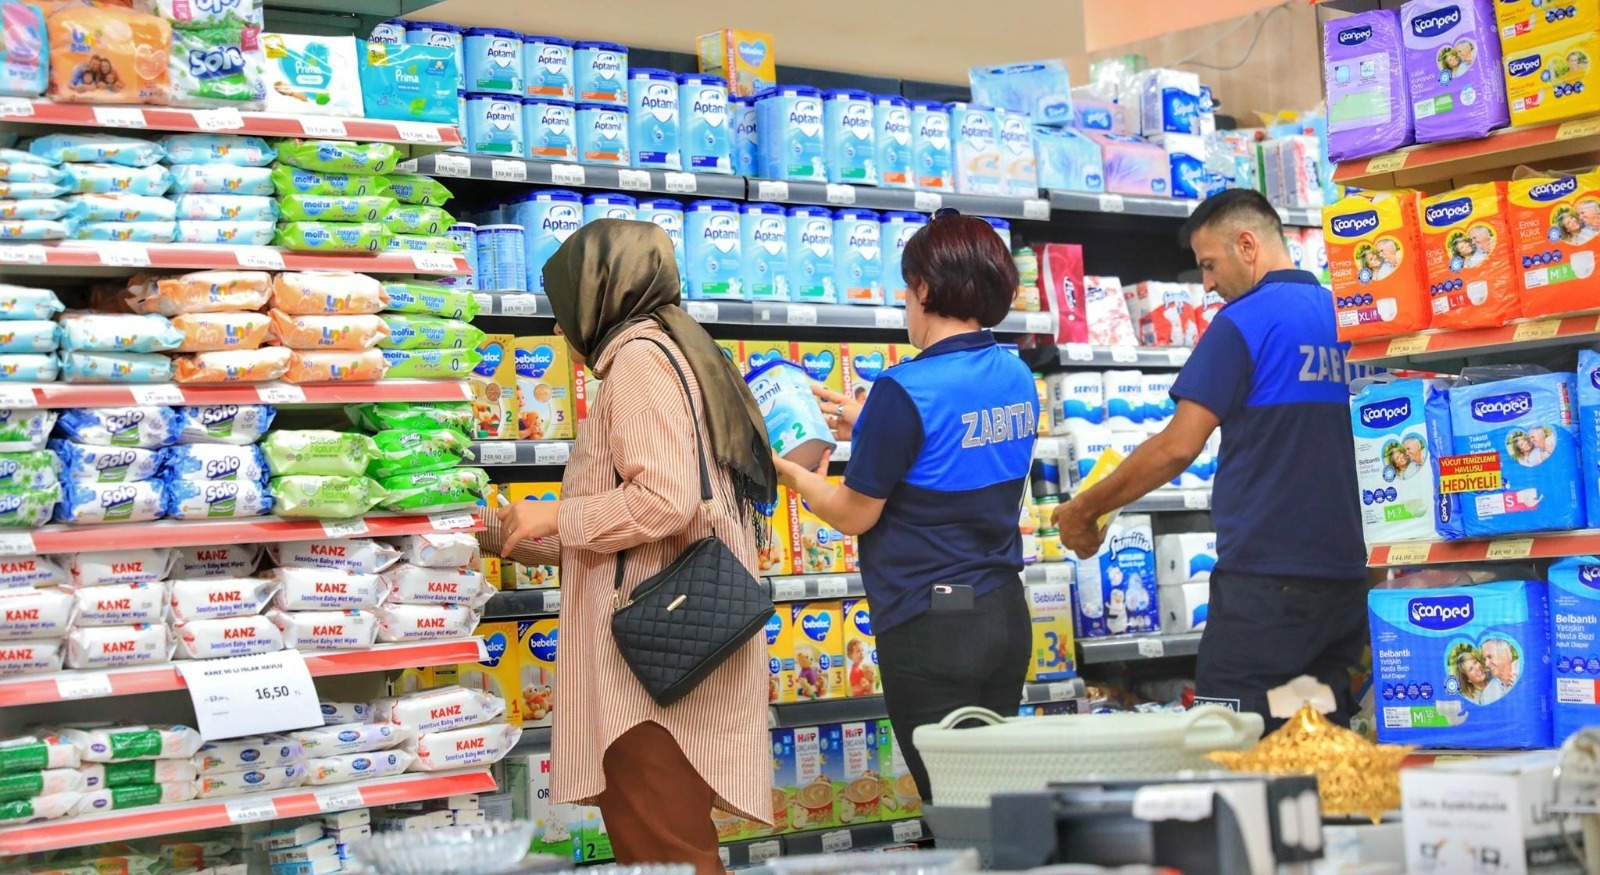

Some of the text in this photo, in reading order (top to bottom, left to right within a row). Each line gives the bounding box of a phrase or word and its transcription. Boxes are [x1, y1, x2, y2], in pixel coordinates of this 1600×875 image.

[1419, 10, 1459, 32] canped
[1342, 29, 1372, 42] canped
[488, 48, 516, 58] Aptamil
[538, 54, 566, 66] Aptamil
[1511, 57, 1540, 75] canped
[592, 61, 620, 72] Aptamil
[396, 69, 418, 82] Prima
[487, 112, 515, 122] Aptamil
[542, 116, 569, 126] Aptamil
[595, 121, 622, 132] Aptamil
[1535, 181, 1575, 198] canped
[1431, 203, 1470, 221] canped
[1340, 217, 1377, 234] canped
[305, 230, 330, 238] molfix
[1550, 270, 1559, 280] M
[1450, 299, 1456, 307] L
[1359, 313, 1370, 321] XL
[203, 404, 238, 423] Solo
[1369, 404, 1409, 422] canped
[1480, 398, 1529, 417] canped
[106, 411, 144, 433] Solo
[505, 411, 513, 422] 2
[557, 411, 564, 422] 3
[792, 422, 807, 440] 2
[962, 402, 1036, 449] ZABITA
[97, 450, 136, 469] Solo
[1441, 455, 1496, 466] VÜCUT TEMİZLEME
[207, 456, 240, 477] Solo
[1455, 465, 1482, 473] HAVLUSU
[1443, 472, 1497, 492] HEDİYELİ!
[102, 485, 137, 506] Solo
[206, 482, 238, 502] Solo
[1505, 495, 1514, 507] S
[792, 497, 803, 553] EKONOMİK
[197, 550, 228, 561] KANZ
[311, 545, 345, 557] KANZ
[836, 545, 842, 558] 2
[1, 561, 36, 574] KANZ
[112, 562, 142, 574] KANZ
[347, 559, 362, 568] Wipes
[490, 561, 498, 574] 1
[316, 582, 347, 593] KANZ
[428, 582, 458, 593] KANZ
[209, 591, 242, 603] KANZ
[301, 594, 324, 602] Sensitive
[325, 595, 337, 603] Baby
[436, 594, 448, 602] Baby
[97, 599, 131, 610] KANZ
[6, 609, 39, 621] KANZ
[1419, 603, 1470, 621] canped
[417, 618, 445, 628] KANZ
[803, 620, 830, 628] bebelac
[1556, 614, 1597, 624] Belbantlı
[224, 627, 255, 639] KANZ
[313, 625, 343, 636] KANZ
[1556, 632, 1594, 640] Hasta Bezi
[103, 641, 136, 653] KANZ
[322, 637, 334, 645] Baby
[0, 648, 33, 660] KANZ
[1044, 631, 1060, 667] 3
[1379, 649, 1410, 658] Belbantlı
[787, 675, 794, 687] 3
[836, 671, 842, 684] 3
[255, 685, 289, 700] 16,50
[431, 705, 461, 719] KANZ
[513, 700, 519, 713] 1
[418, 714, 478, 731] Sensitive Baby Wet Wipes
[1414, 712, 1423, 723] M
[1425, 710, 1434, 718] 18
[456, 738, 484, 750] KANZ
[586, 843, 596, 859] 2
